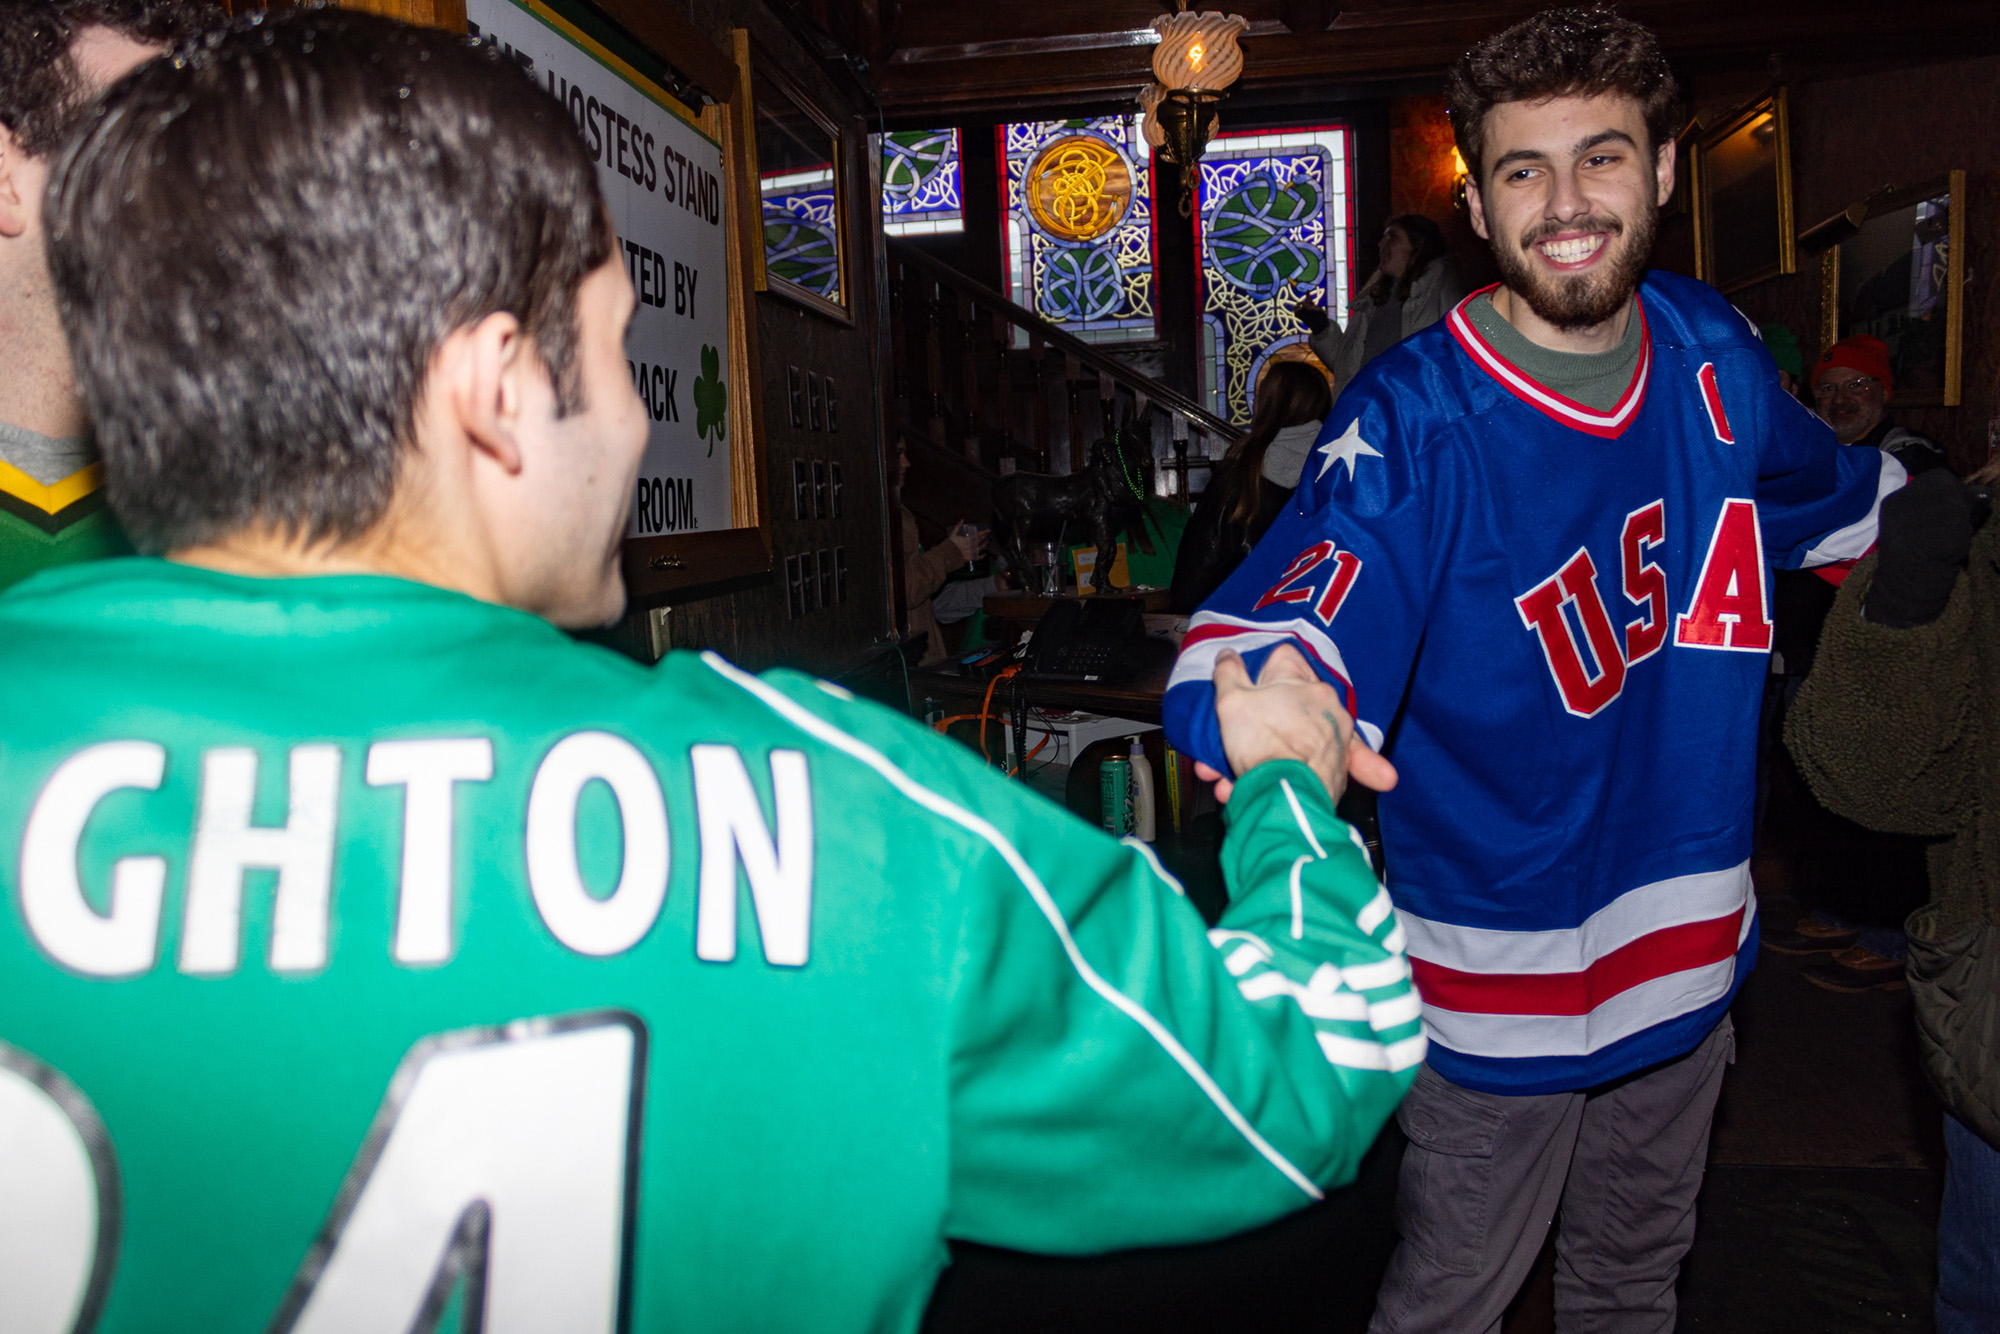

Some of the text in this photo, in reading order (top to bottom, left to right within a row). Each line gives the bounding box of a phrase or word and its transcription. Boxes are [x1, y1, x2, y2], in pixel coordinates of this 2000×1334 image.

[664, 145, 719, 225] STAND
[617, 236, 698, 319] TED BY
[627, 360, 679, 422] ACK
[1251, 540, 1363, 628] 21
[1514, 498, 1774, 718] USA
[20, 731, 814, 977] GHTON
